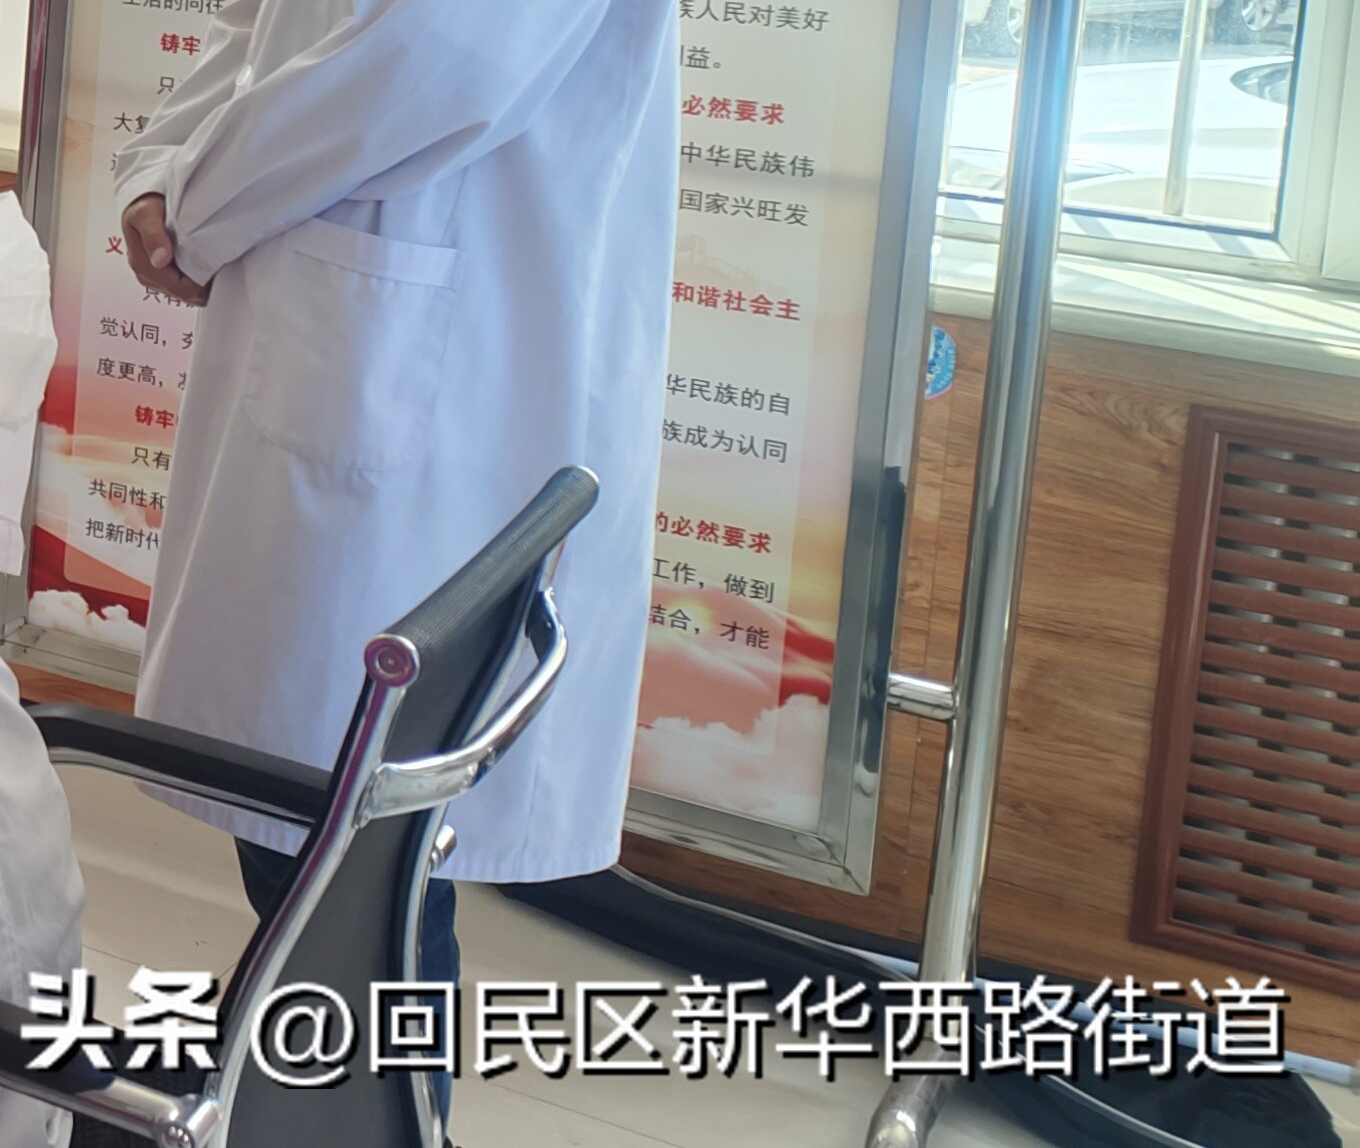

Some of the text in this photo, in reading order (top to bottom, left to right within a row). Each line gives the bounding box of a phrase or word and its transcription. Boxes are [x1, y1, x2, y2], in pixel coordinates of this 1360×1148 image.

[679, 44, 722, 70] 益。
[681, 93, 786, 125] 必然要求
[680, 141, 815, 178] 中华民族伟
[678, 188, 811, 227] 国家兴旺发
[671, 281, 802, 322] 和谐社会主
[665, 373, 791, 417] 华民族的自
[131, 445, 172, 472] 只有
[84, 516, 162, 552] 把新时代
